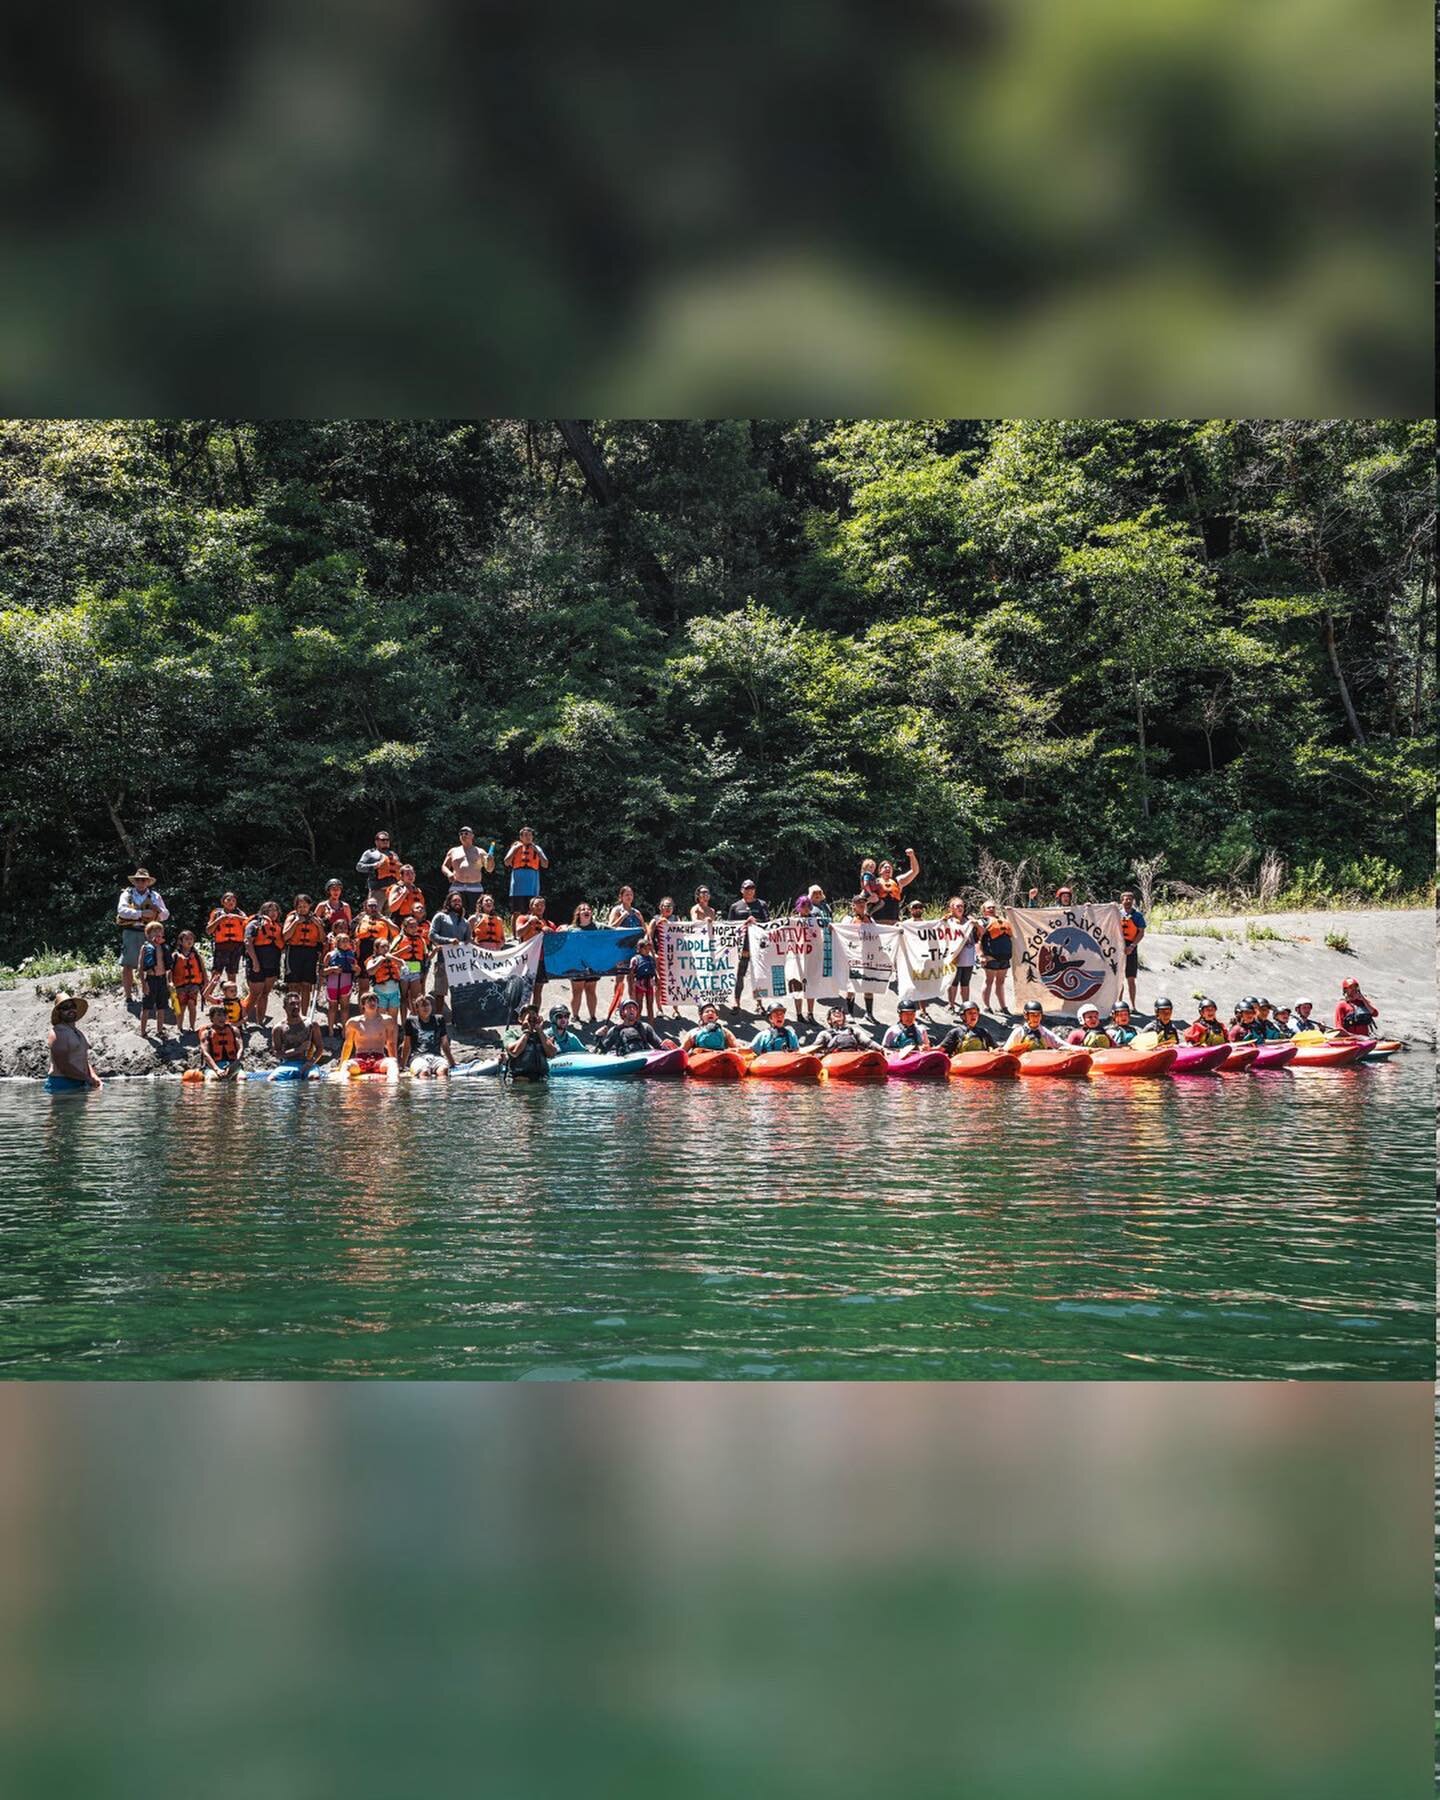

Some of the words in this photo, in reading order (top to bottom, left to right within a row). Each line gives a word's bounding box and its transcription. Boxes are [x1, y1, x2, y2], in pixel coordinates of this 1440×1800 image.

[712, 926, 737, 937] HOPI
[768, 928, 811, 943] NATIVE
[917, 927, 965, 941] UNDAM
[1048, 919, 1062, 929] to
[1063, 910, 1117, 958] Rivers
[676, 938, 717, 953] PADDLE
[776, 944, 813, 956] LAND
[448, 962, 468, 973] THE
[469, 954, 529, 971] KAMATH
[666, 944, 675, 977] HUPA
[677, 956, 735, 972] TRIBAL
[680, 973, 737, 991] WATERS
